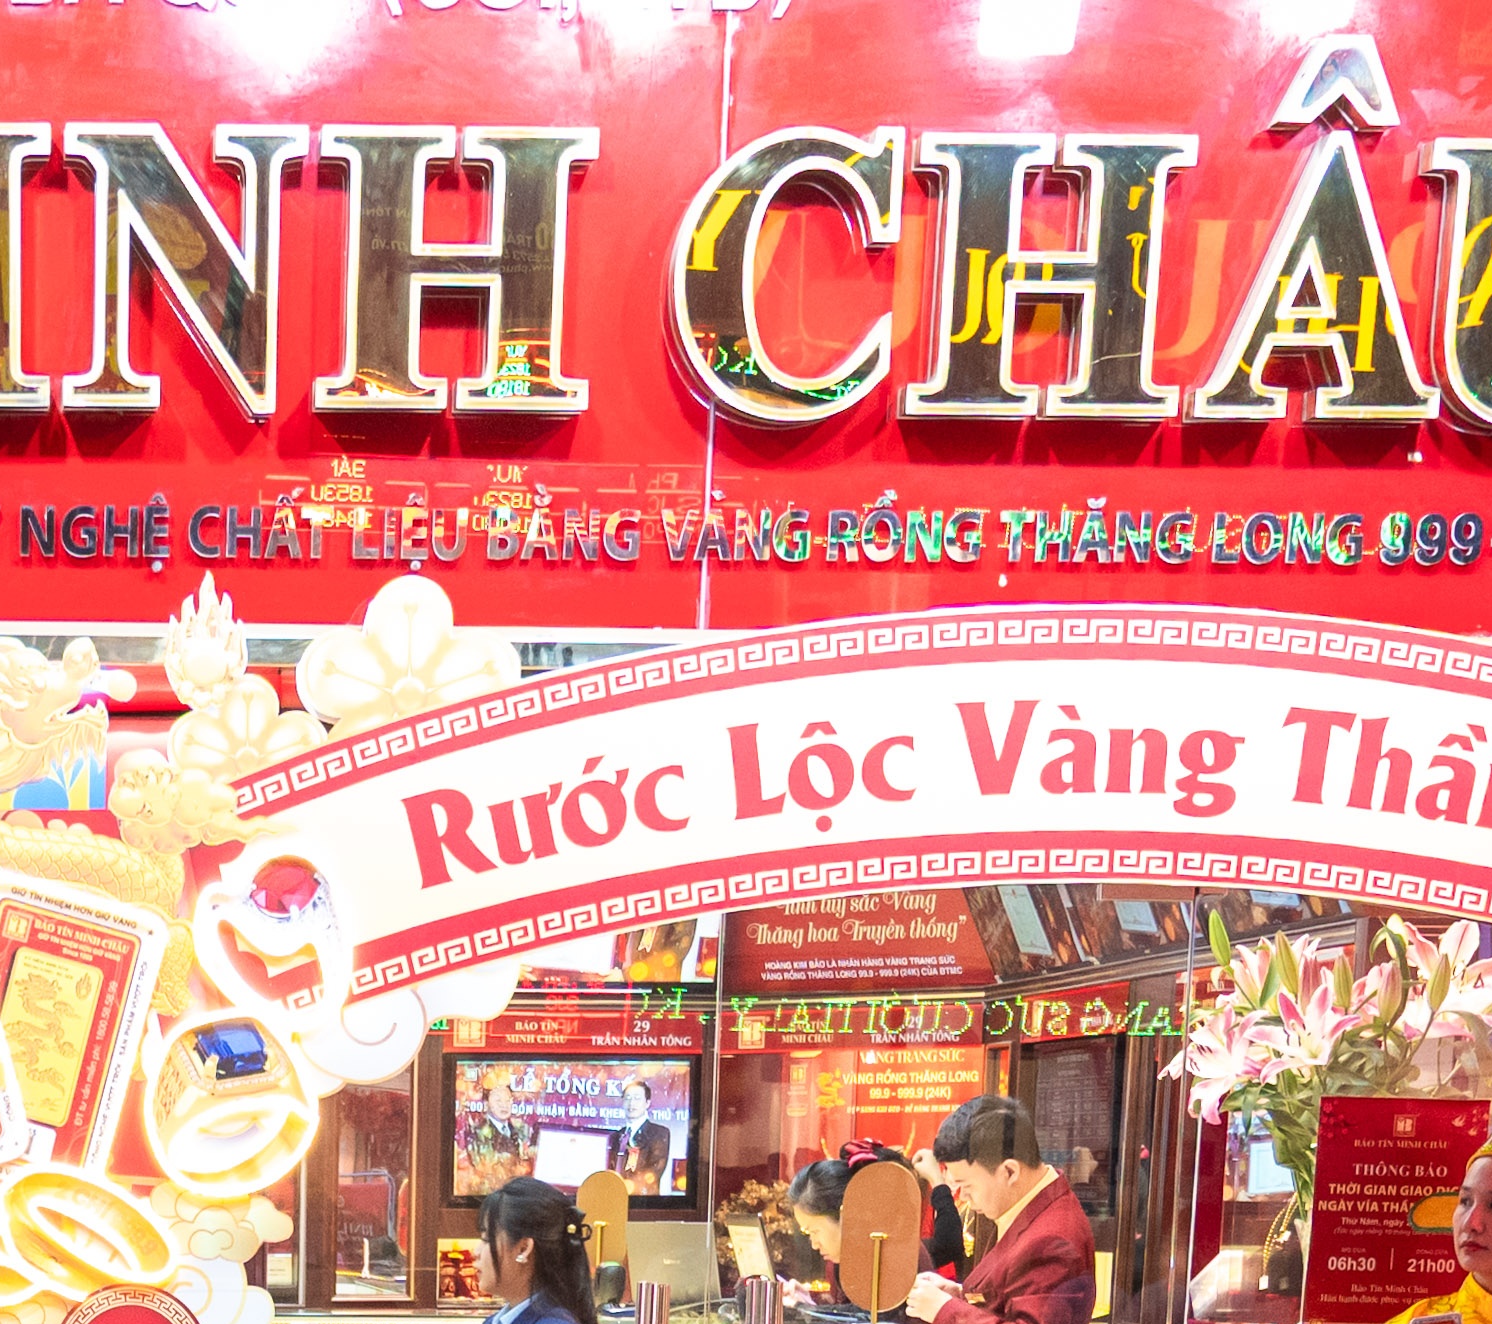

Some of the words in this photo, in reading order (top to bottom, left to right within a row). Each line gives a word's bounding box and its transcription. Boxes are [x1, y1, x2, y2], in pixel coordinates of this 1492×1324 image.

[21, 492, 172, 573] NGHỆ
[189, 491, 325, 561] CHẤT
[352, 492, 468, 572] LIỆU
[489, 483, 641, 562] BẰNG
[666, 489, 812, 564] VÀNG
[827, 489, 983, 564] RỒNG
[1000, 495, 1196, 565] THĂNG
[1214, 511, 1364, 566] LONG
[1378, 511, 1483, 567] 999
[402, 755, 691, 891] Rước
[725, 720, 918, 832] Lộc
[957, 698, 1245, 818] Vàng
[633, 1021, 651, 1033] 29
[591, 1034, 621, 1046] TRẦN
[623, 1035, 658, 1046] NHÂN
[661, 1034, 692, 1047] TÔNG
[510, 1067, 536, 1093] LỄ
[545, 1066, 600, 1096] TỔNG
[842, 1069, 873, 1084] VÀNG
[876, 1068, 908, 1084] RỒNG
[909, 1070, 944, 1083] THĂNG
[946, 1070, 978, 1082] LONG
[870, 1087, 890, 1099] 99.9
[898, 1087, 923, 1099] 999.9
[925, 1087, 951, 1100] (24K)
[1352, 1161, 1410, 1177] THÔNG
[1415, 1162, 1448, 1178] BÁO
[1329, 1182, 1361, 1195] THỜI
[1364, 1184, 1400, 1196] GIAN
[1403, 1185, 1433, 1196] GIAO
[1318, 1199, 1355, 1212] NGÀY
[1357, 1199, 1380, 1212] VÍA
[1328, 1257, 1376, 1272] 06h30
[1407, 1258, 1455, 1274] 21h00
